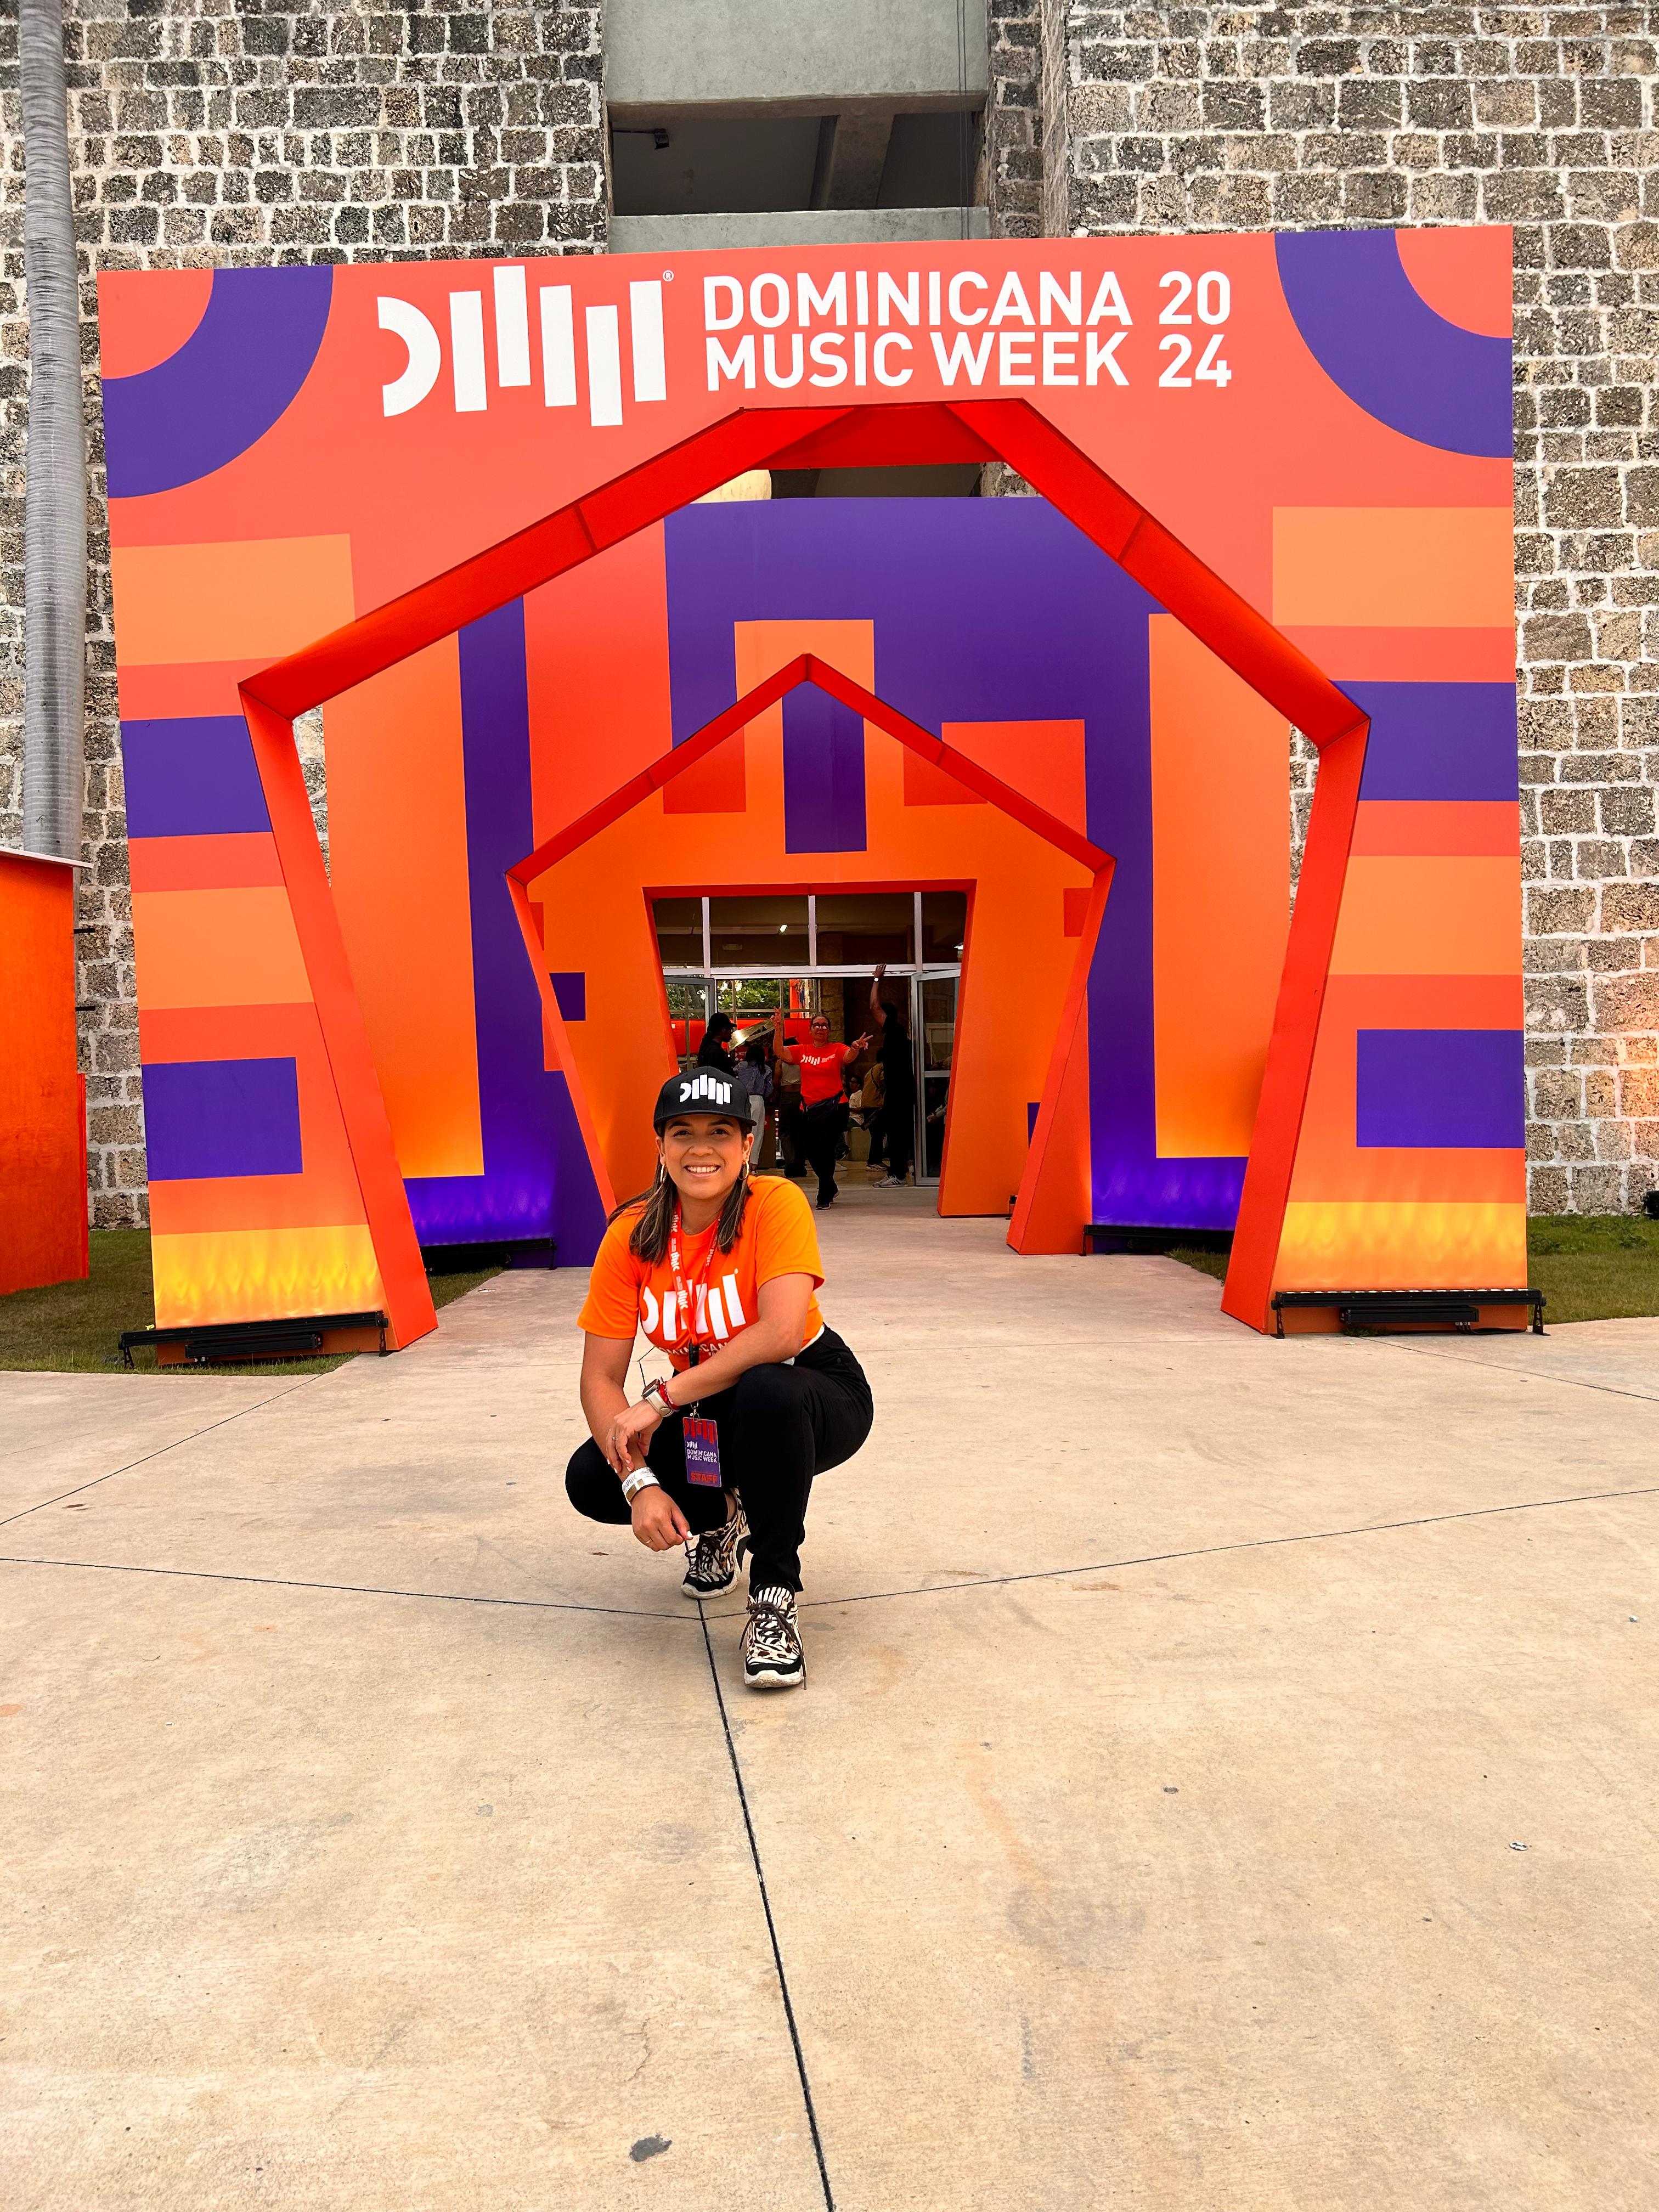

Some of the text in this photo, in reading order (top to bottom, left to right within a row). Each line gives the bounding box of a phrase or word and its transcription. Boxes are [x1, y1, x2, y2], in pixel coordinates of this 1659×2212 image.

[703, 270, 1231, 331] DOMINICANA 20
[706, 331, 1232, 392] MUSIC WEEK 24
[687, 1449, 717, 1458] DOMINICANA
[691, 1472, 718, 1483] STAFF
